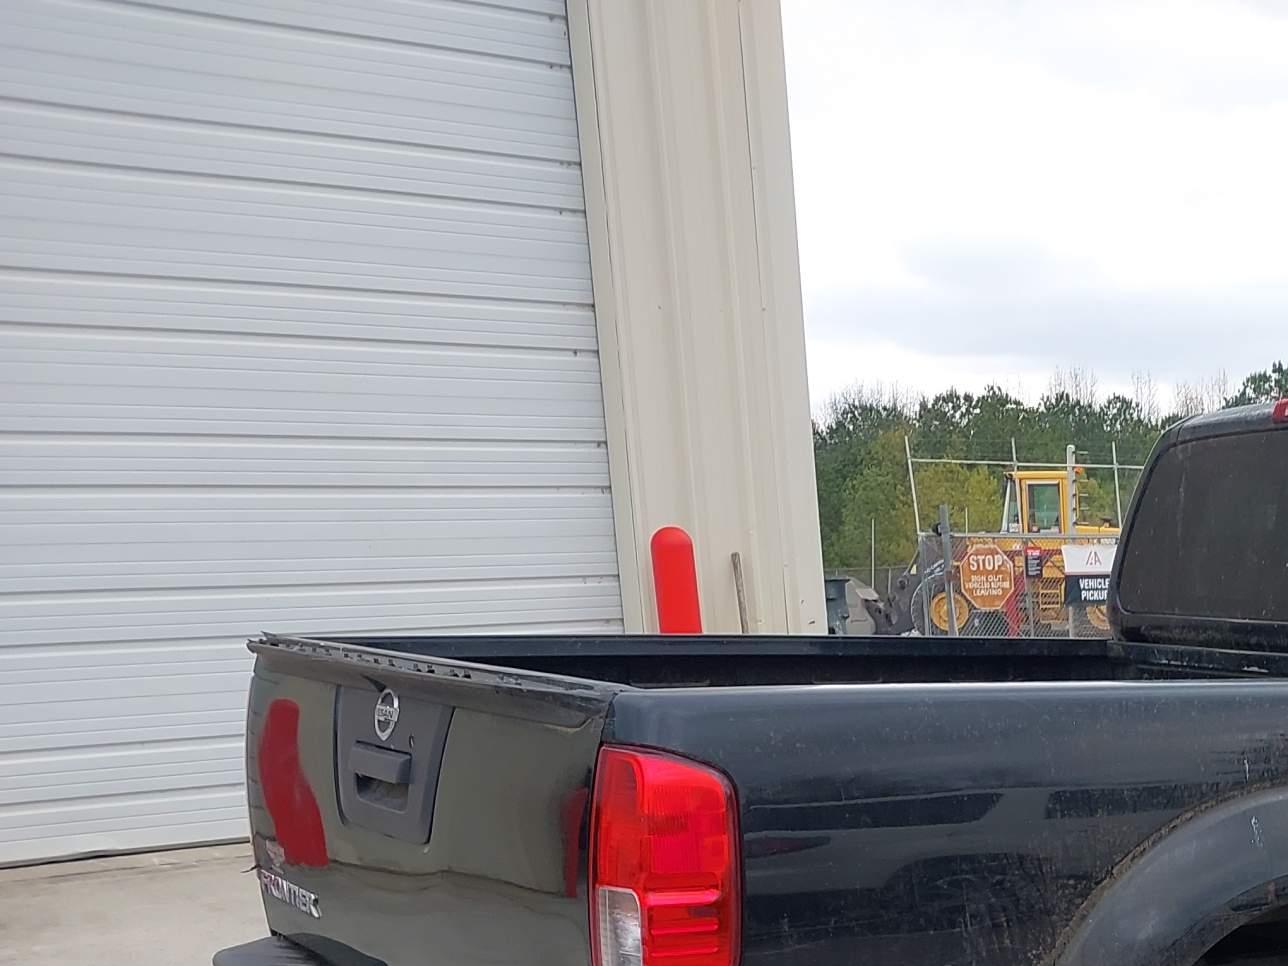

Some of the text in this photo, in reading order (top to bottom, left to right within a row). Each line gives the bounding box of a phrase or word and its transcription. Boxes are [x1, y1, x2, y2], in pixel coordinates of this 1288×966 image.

[969, 554, 1003, 571] STOP
[973, 588, 1002, 596] LEAVING
[261, 869, 322, 918] FRONTIER
